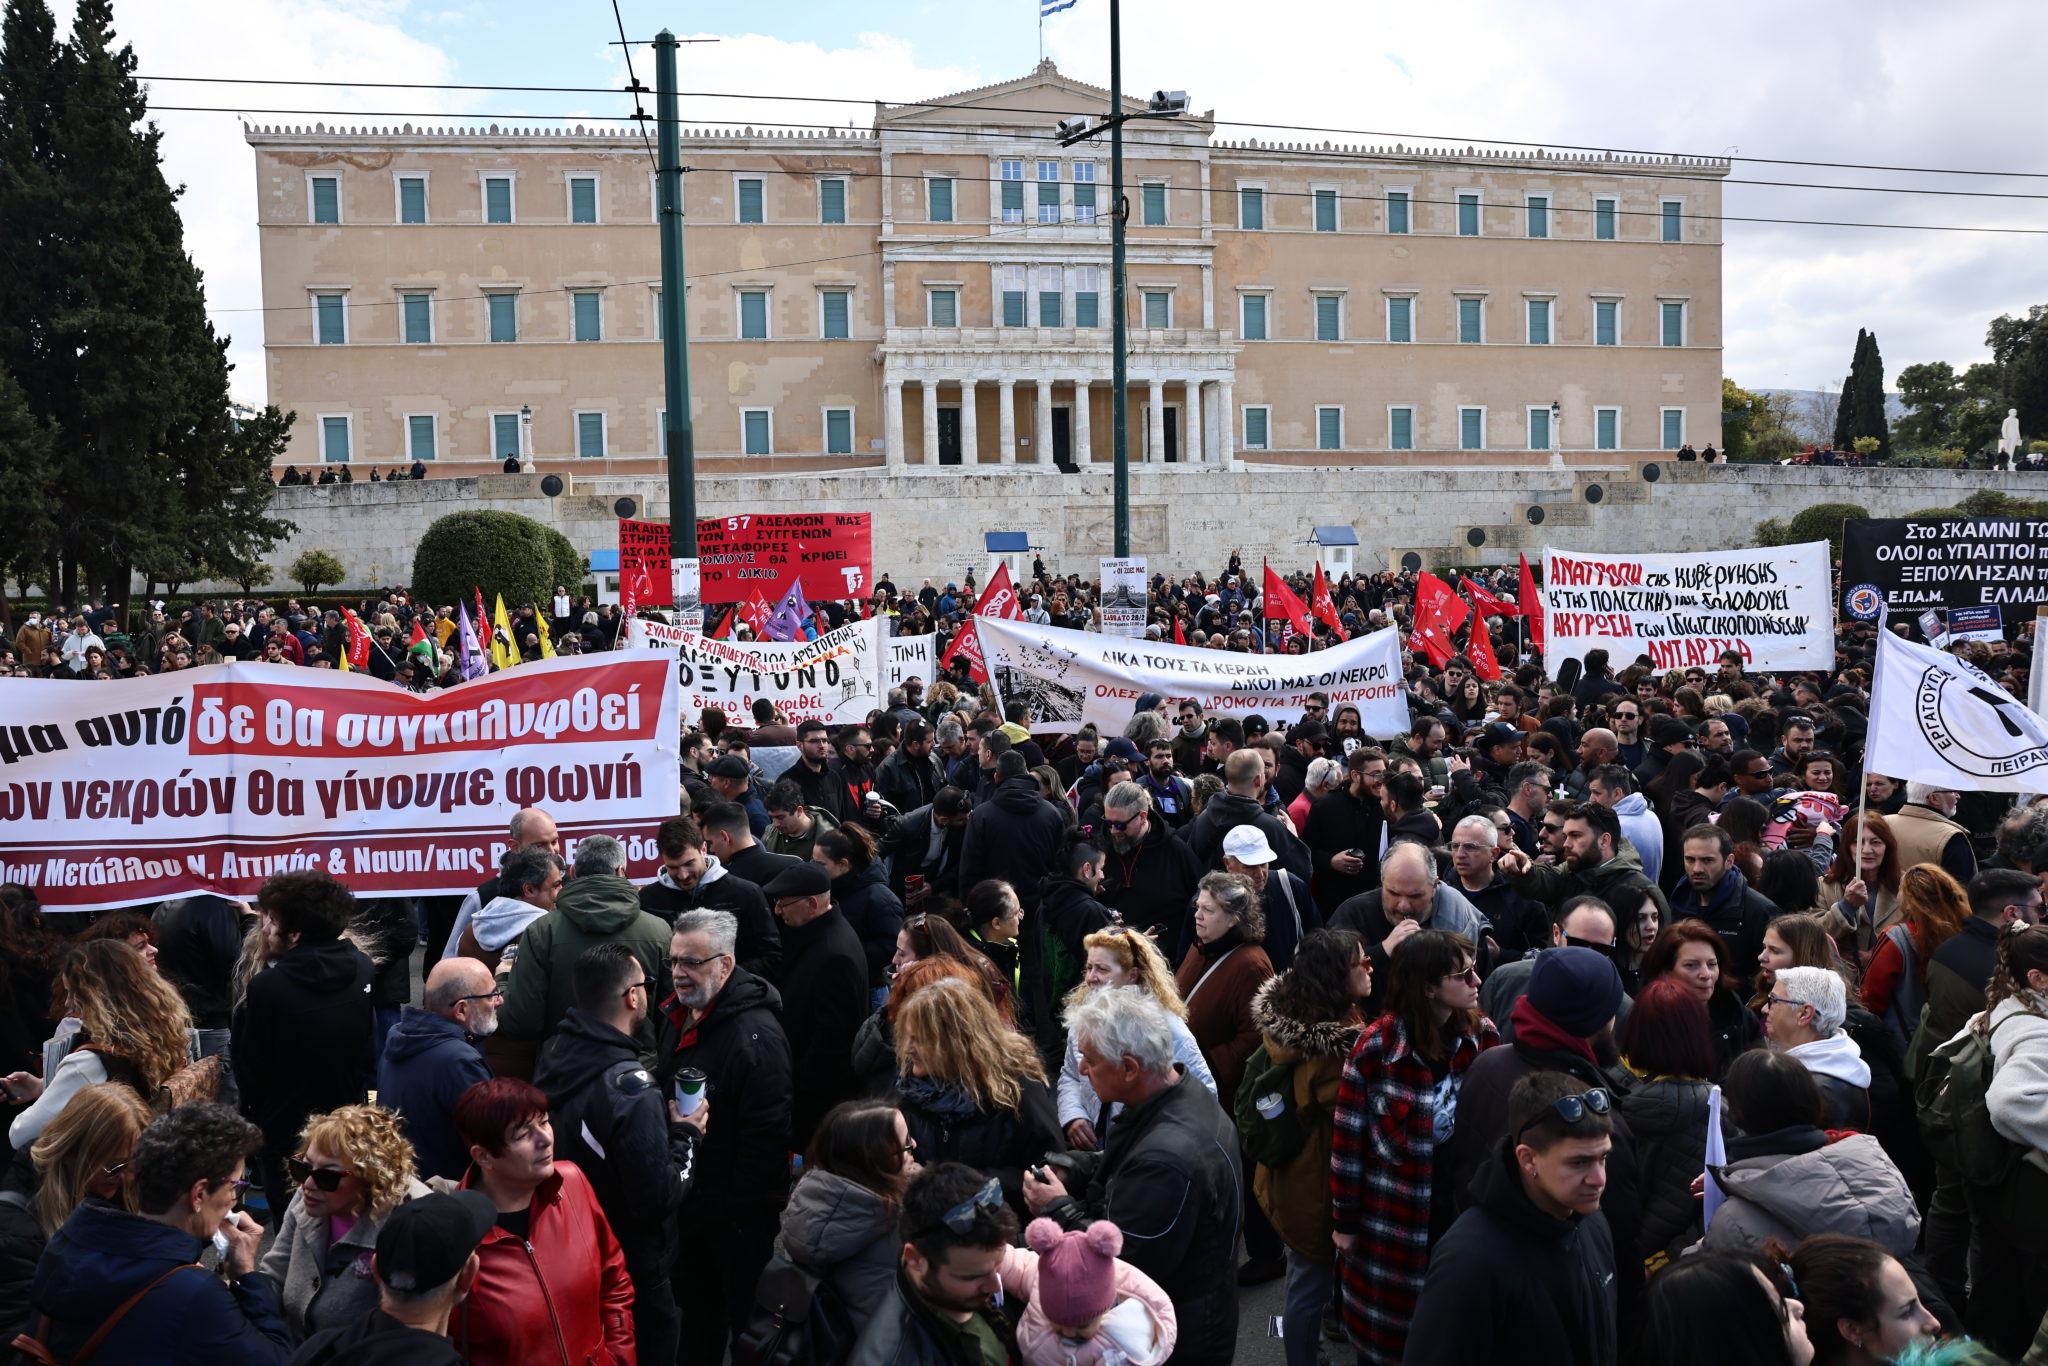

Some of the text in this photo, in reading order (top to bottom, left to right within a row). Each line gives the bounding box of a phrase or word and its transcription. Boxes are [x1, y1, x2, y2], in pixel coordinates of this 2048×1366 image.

[727, 516, 751, 531] 57
[756, 515, 824, 527] ΑΔΕΛΦΩΝ
[835, 515, 862, 526] ΜΑΣ
[1905, 523, 1937, 540] Στο
[1940, 522, 2021, 538] ΣΚΑΜΝΙ
[756, 528, 832, 540] ΣΥΓΓΕΝΩΝ
[701, 543, 789, 554] ΜΕΤΑΦΟΡΕΣ
[769, 554, 788, 564] ΘΑ
[801, 550, 848, 563] ΚΡΙΘΕΙ
[1876, 544, 1923, 561] ΟΛΟΙ
[1927, 548, 1943, 560] οι
[1947, 543, 2036, 560] ΥΠΑΙΤΙΟΙ
[702, 568, 778, 582] ΤΟ ΔΙΚΙΟ
[1550, 556, 1643, 587] ΑΝΑΤΡΟΠΗ
[1900, 565, 2035, 582] ΞΕΠΟΥΛΗΣΑΝ
[1888, 586, 2048, 604] Ε.ΠΑ.Μ. ΕΛΛΑΔ
[645, 622, 696, 646] ΣΥΛΛΟΓΟΣ
[1553, 613, 1633, 637] ΑΚΥΡΩΣΗ
[1102, 650, 1270, 676] ΔΙΚΑ ΤΟΥΣ ΤΑ ΚΕΡΔΗ
[1231, 662, 1389, 691] ΔΙΚΟΙ ΜΑΣ ΟΙ ΝΕΚΡΟΙ
[775, 692, 825, 711] κριθεί
[1203, 695, 1259, 710] ΔΡΟΜΟ
[1262, 697, 1285, 707] ΓΙΑ
[1291, 695, 1310, 706] ΤΗ
[1327, 684, 1397, 703] ΝΑΤΡΟΠΗ
[75, 696, 187, 747] αυτό
[197, 697, 255, 744] δε
[265, 698, 325, 747] θα
[336, 683, 641, 753] συγκαλυφθεί
[62, 769, 237, 825] νεκρών
[248, 769, 305, 816] θα
[315, 767, 495, 819] γίνουμε
[505, 753, 642, 809] φωνή
[44, 856, 182, 887] Μετάλλου
[221, 848, 321, 879] Αττικής
[327, 847, 348, 875] &
[353, 843, 484, 875] Ναυπ/κης
